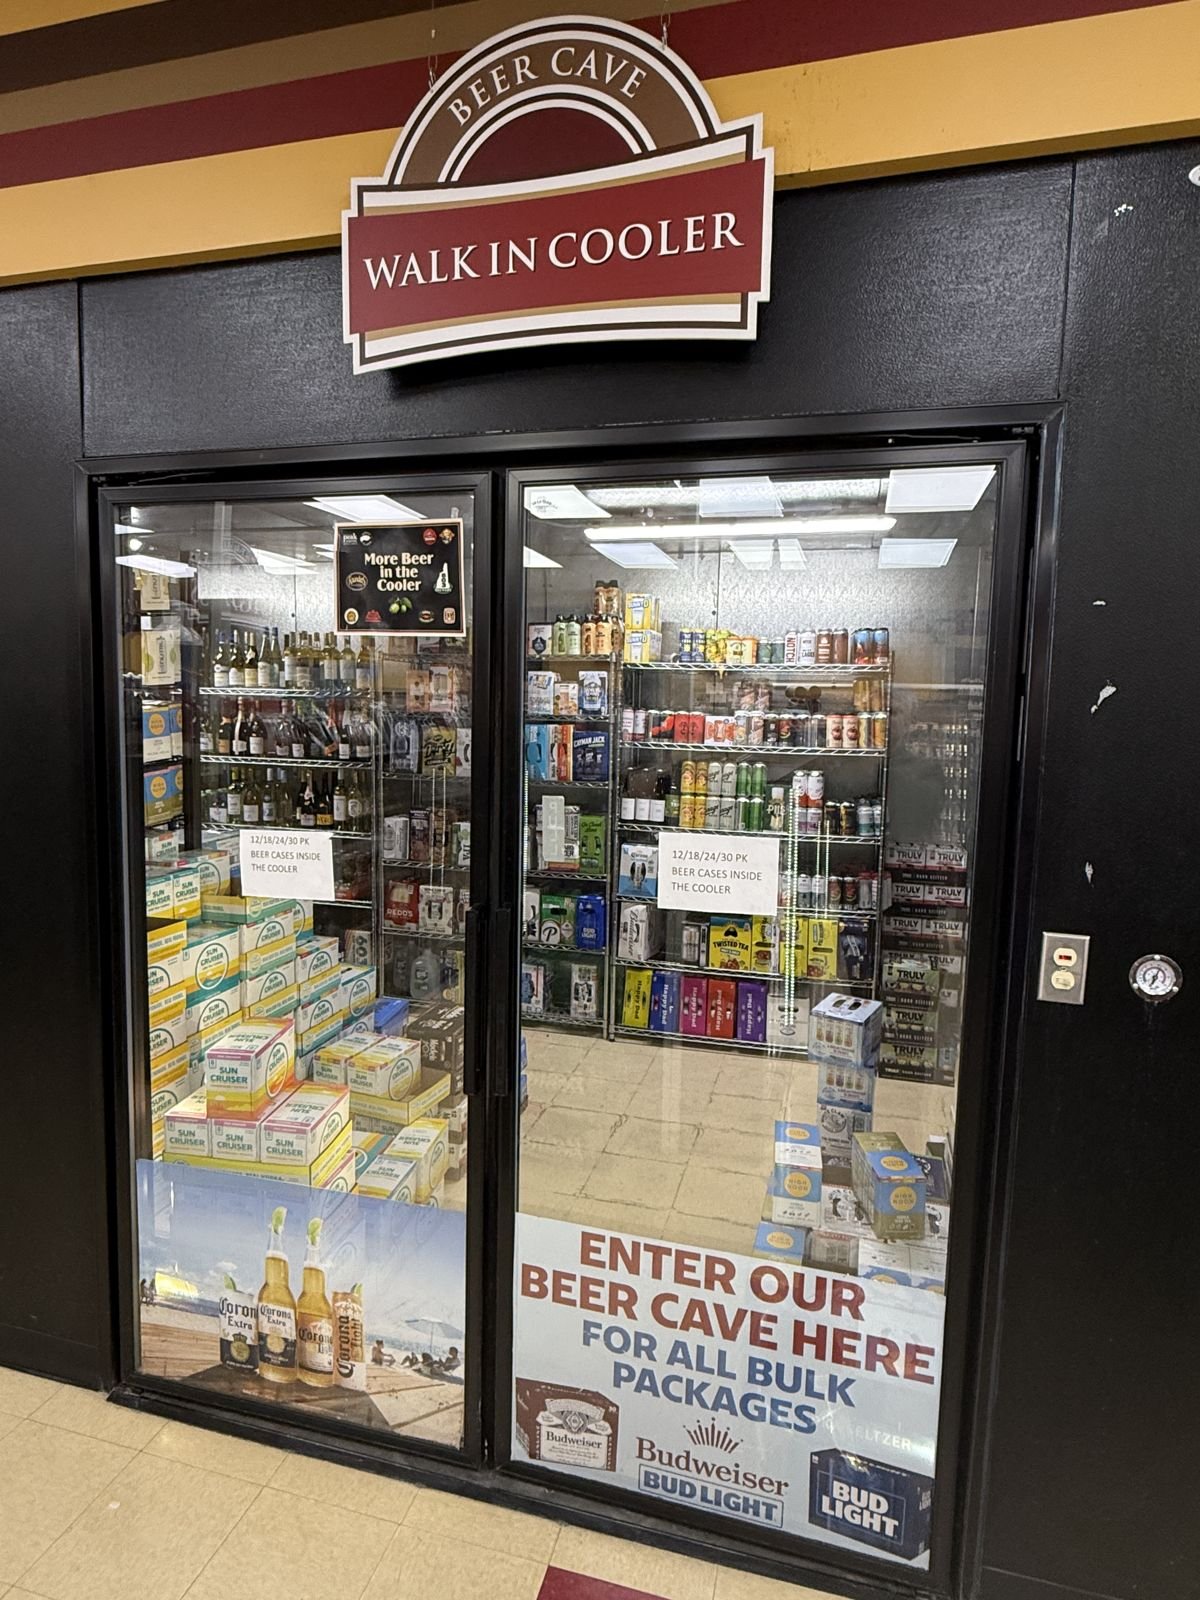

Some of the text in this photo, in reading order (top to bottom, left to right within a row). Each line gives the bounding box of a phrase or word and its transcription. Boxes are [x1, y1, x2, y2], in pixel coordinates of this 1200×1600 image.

[447, 46, 649, 127] BEER CAVE
[363, 211, 744, 291] WALK IN COOLER
[364, 552, 434, 565] More Beer
[380, 566, 418, 578] in the
[377, 579, 421, 591] Cooler
[786, 637, 796, 663] NOTCH
[250, 834, 310, 846] 12/18/24/30 PK
[251, 850, 320, 860] BEER CASES INSIDE
[672, 850, 748, 863] 12/18/24/30 PK
[896, 850, 963, 862] TRULY TRULY
[252, 863, 297, 873] THE COOLER
[672, 866, 762, 881] BEER CASES INSIDE
[152, 889, 165, 898] SUN
[175, 886, 198, 898] CRUISER
[671, 881, 731, 894] THE COOLER
[895, 884, 962, 896] TRULY TRULY
[893, 918, 959, 930] TRULY TRULY
[206, 947, 218, 957] SUN
[713, 941, 749, 951] TWISTED TEA
[201, 952, 224, 966] CRUISER
[897, 969, 925, 980] TRULY
[209, 1003, 219, 1012] SUN
[202, 1007, 225, 1022] CRUISER
[896, 1011, 924, 1020] TRULY
[893, 1045, 925, 1056] TRULY
[210, 1074, 248, 1084] CRUISER
[350, 1077, 373, 1088] CRUISER
[177, 1129, 196, 1137] SUN
[225, 1134, 243, 1142] SUN
[169, 1136, 205, 1146] CRUISER
[217, 1141, 253, 1151] CRUISER
[276, 1139, 294, 1148] SUN
[266, 1145, 303, 1157] CRUISER
[580, 1230, 866, 1321] ENTER OUR
[260, 1303, 292, 1321] Corona
[228, 1313, 253, 1330] Extra
[267, 1315, 286, 1327] Extra
[520, 1263, 935, 1385] BEER CAVE HERE
[336, 1315, 355, 1378] Corona
[582, 1319, 857, 1408] FOR ALL BULK
[613, 1361, 818, 1435] PACKAGES
[546, 1430, 602, 1449] Budweiser
[636, 1436, 789, 1497] Budweiser
[643, 1470, 778, 1522] BUD LIGHT
[833, 1480, 889, 1514] BUD
[821, 1494, 899, 1538] LIGHT
